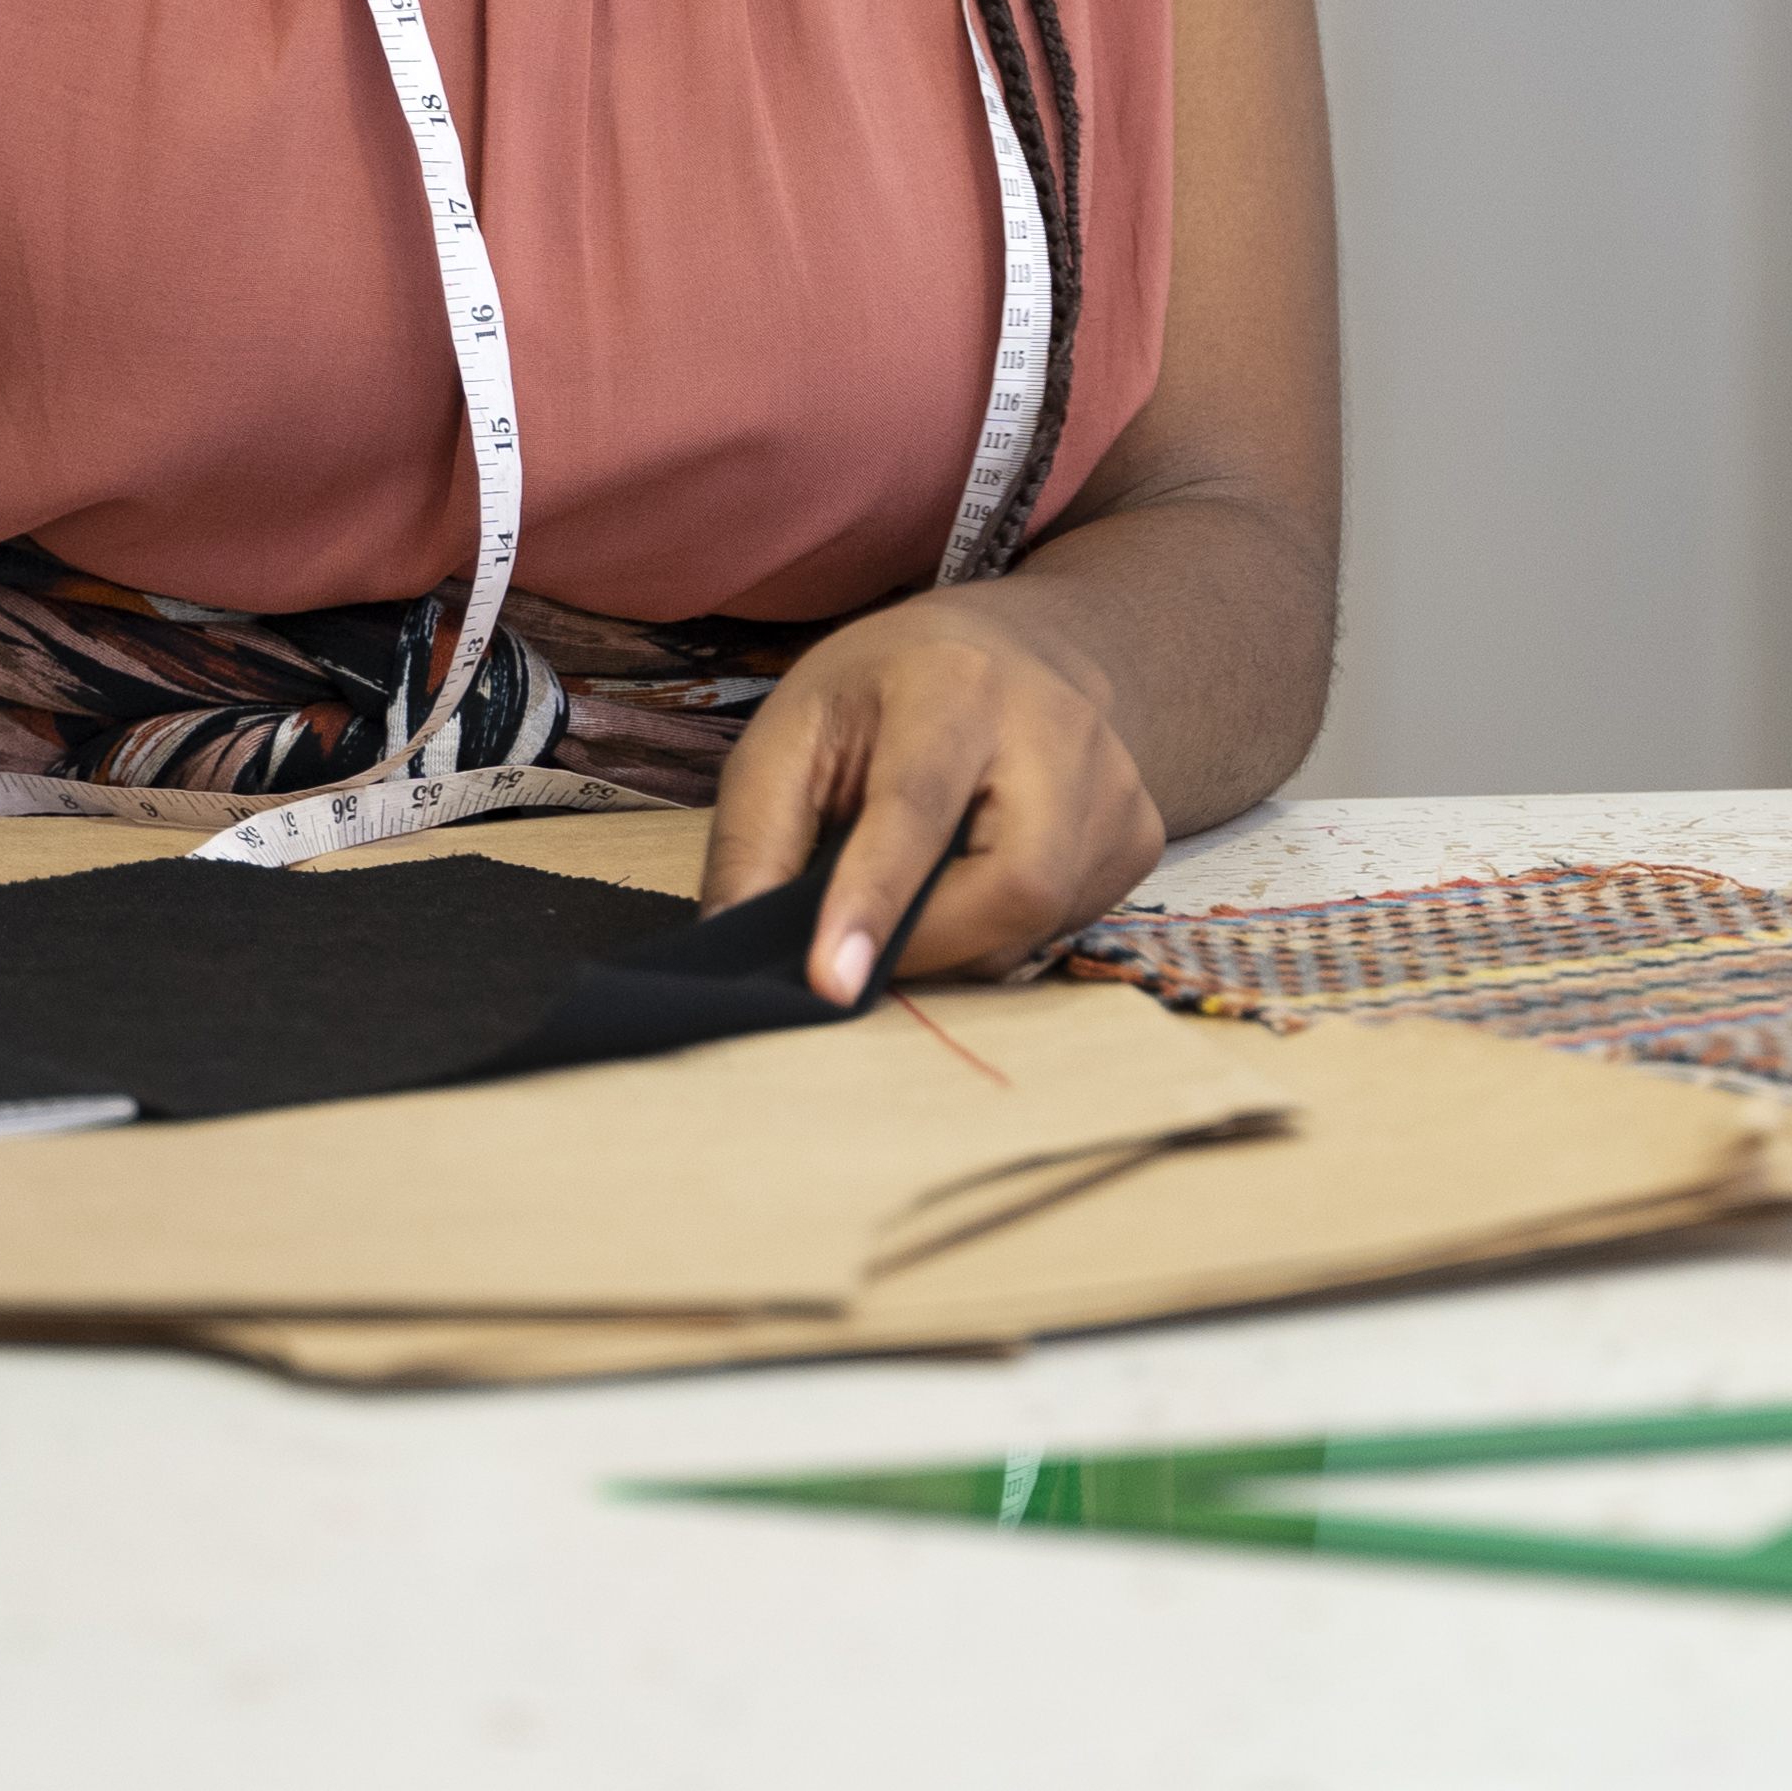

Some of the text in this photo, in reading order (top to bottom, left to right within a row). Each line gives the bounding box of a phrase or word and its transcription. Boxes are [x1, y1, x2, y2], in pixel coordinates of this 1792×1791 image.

[421, 93, 449, 127] 18
[448, 197, 476, 234] 17
[1010, 264, 1032, 283] 113
[470, 304, 499, 343] 16
[1007, 308, 1030, 326] 114
[1001, 350, 1025, 369] 115
[994, 392, 1021, 411] 116
[490, 416, 515, 454] 15
[984, 431, 1012, 450] 117
[973, 468, 1001, 487] 118
[494, 530, 515, 566] 14
[952, 534, 972, 552] 12
[462, 636, 484, 671] 13
[491, 770, 525, 792] 54
[579, 781, 619, 800] 53
[58, 793, 79, 810] 8
[413, 783, 443, 809] 55
[332, 795, 359, 824] 56
[235, 825, 265, 849] 58
